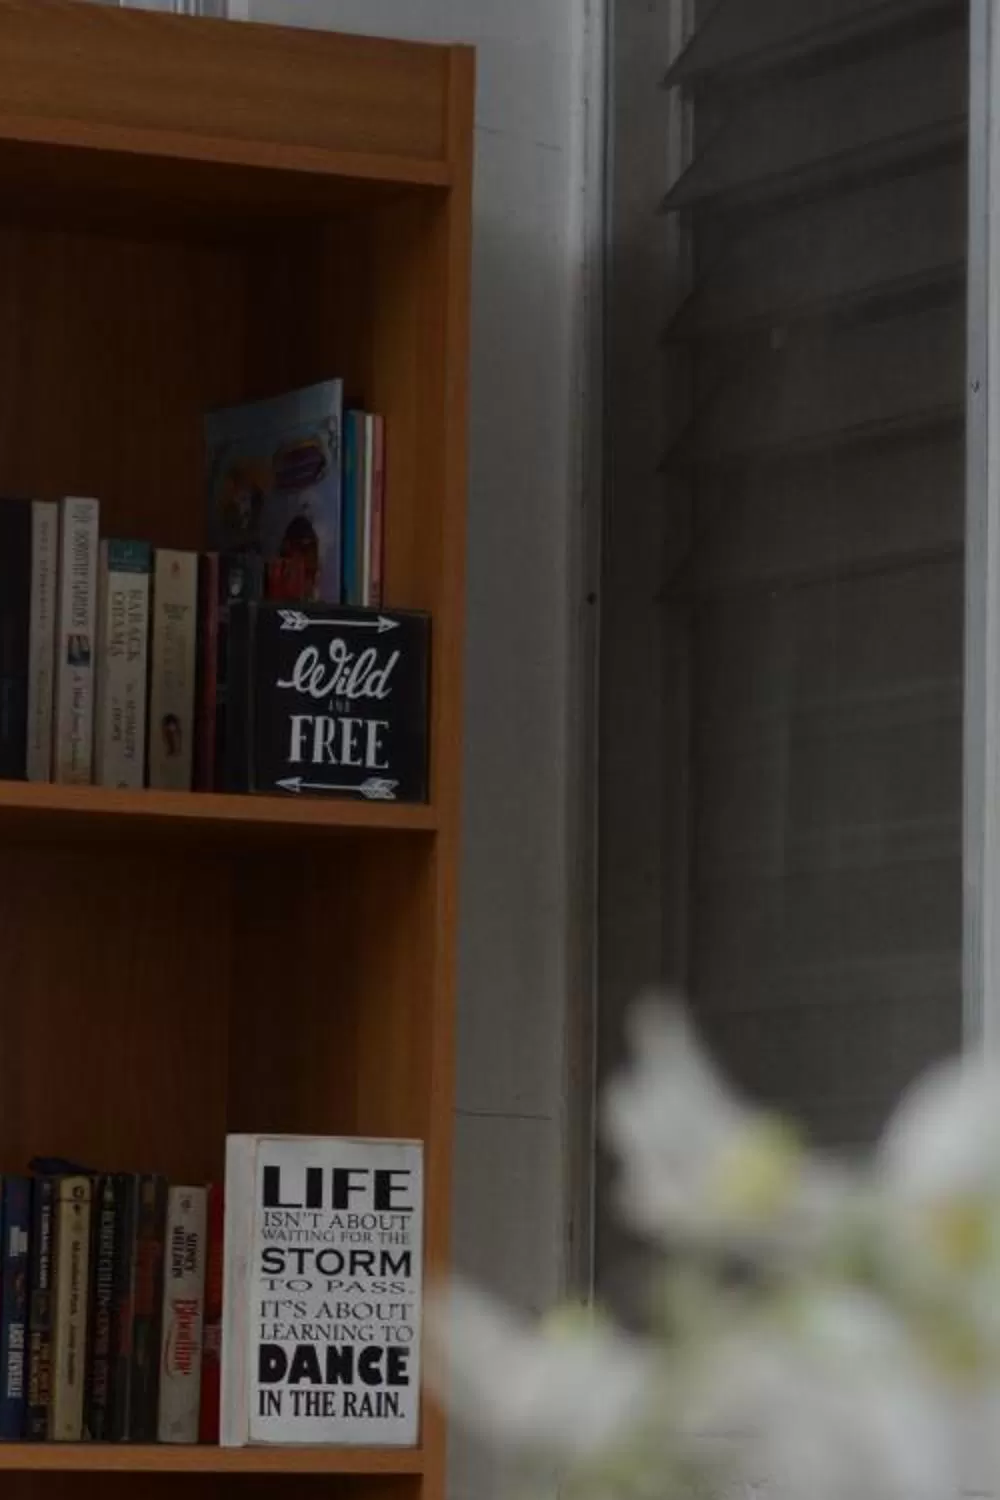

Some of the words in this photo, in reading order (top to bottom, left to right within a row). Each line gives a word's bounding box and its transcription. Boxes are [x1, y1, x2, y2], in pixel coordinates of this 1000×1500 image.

[110, 591, 126, 657] OBAMA
[126, 589, 144, 661] BARACK
[276, 637, 400, 701] Wild
[287, 715, 390, 769] FREE
[262, 1165, 414, 1212] LIFE
[261, 1229, 335, 1243] WAITING
[340, 1231, 372, 1244] FOR
[378, 1232, 410, 1245] THE
[264, 1211, 322, 1228] ISN'T
[328, 1213, 411, 1231] ABOUT
[261, 1247, 412, 1278] STORM
[263, 1278, 313, 1292] TO
[260, 1300, 307, 1318] IT'S
[315, 1302, 411, 1321] ABOUT
[174, 1298, 201, 1375] Bloodline
[260, 1323, 374, 1342] LEARNING
[380, 1325, 415, 1342] TO
[258, 1344, 409, 1386] DANCE
[259, 1389, 282, 1416] IN
[289, 1390, 336, 1417] THE
[343, 1391, 406, 1418] RAIN.
